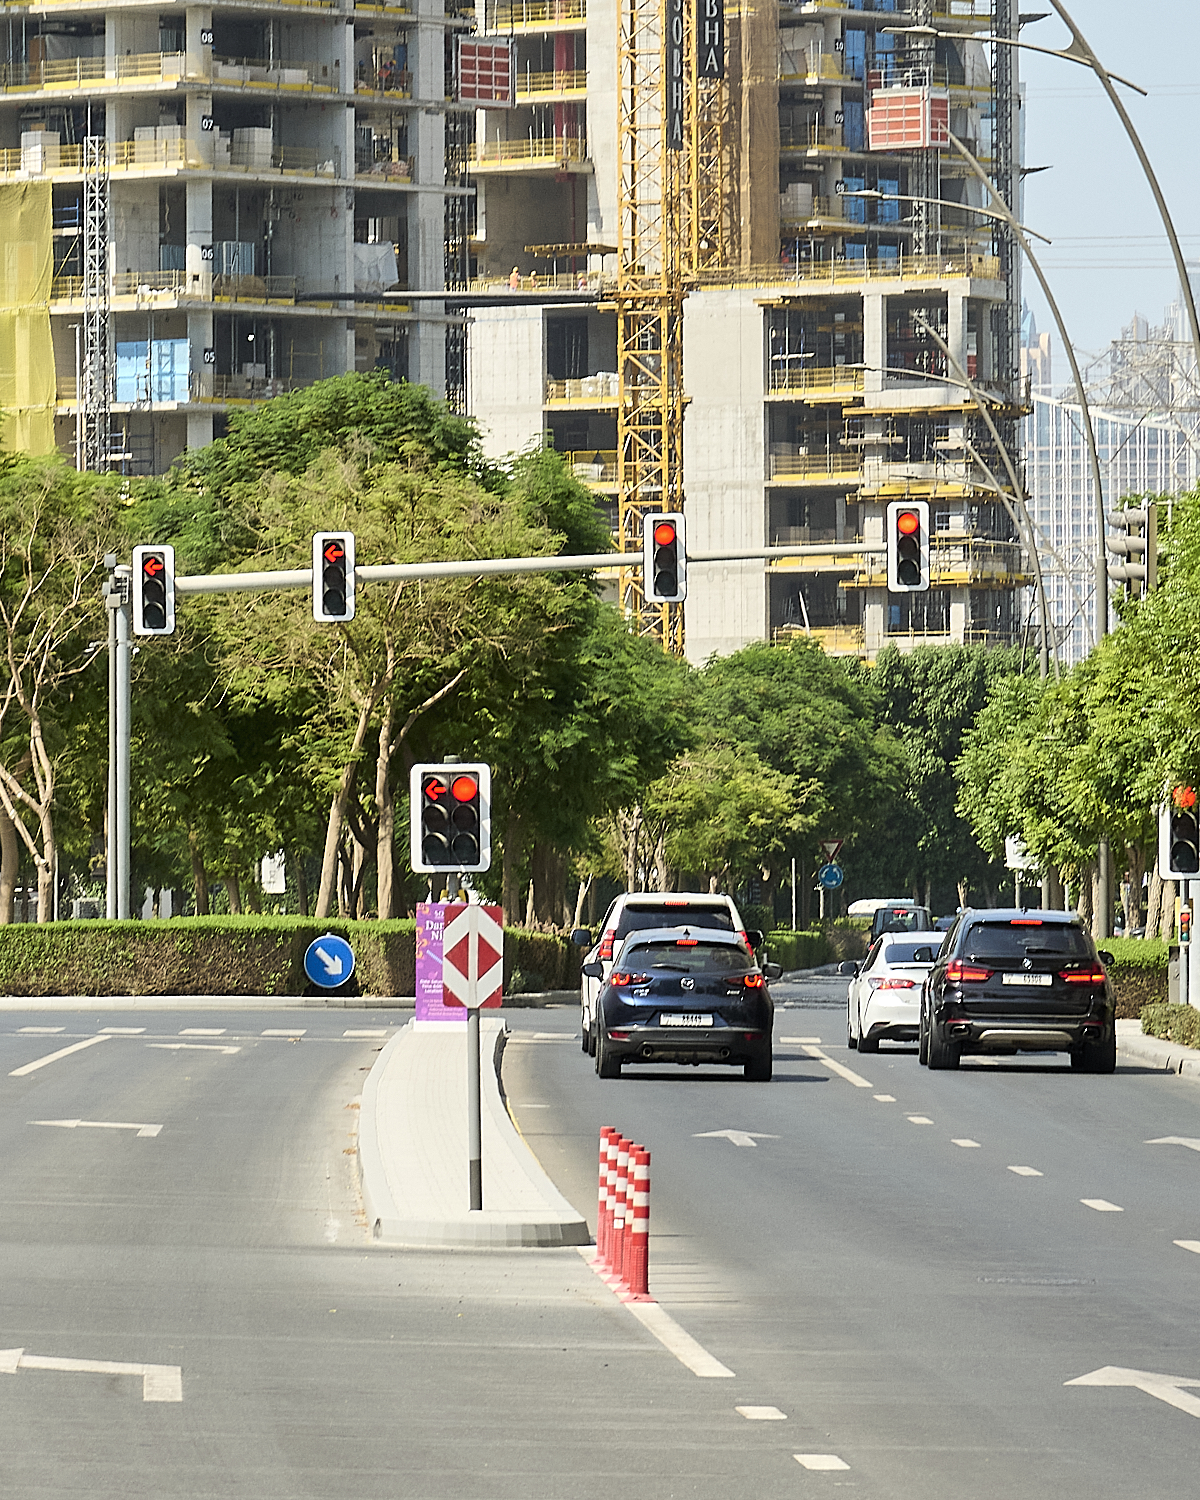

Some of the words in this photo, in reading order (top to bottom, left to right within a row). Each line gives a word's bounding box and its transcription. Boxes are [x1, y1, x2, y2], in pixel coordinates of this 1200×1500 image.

[202, 32, 214, 44] 08
[202, 118, 214, 130] 07
[202, 248, 214, 260] 06
[204, 351, 216, 363] 05
